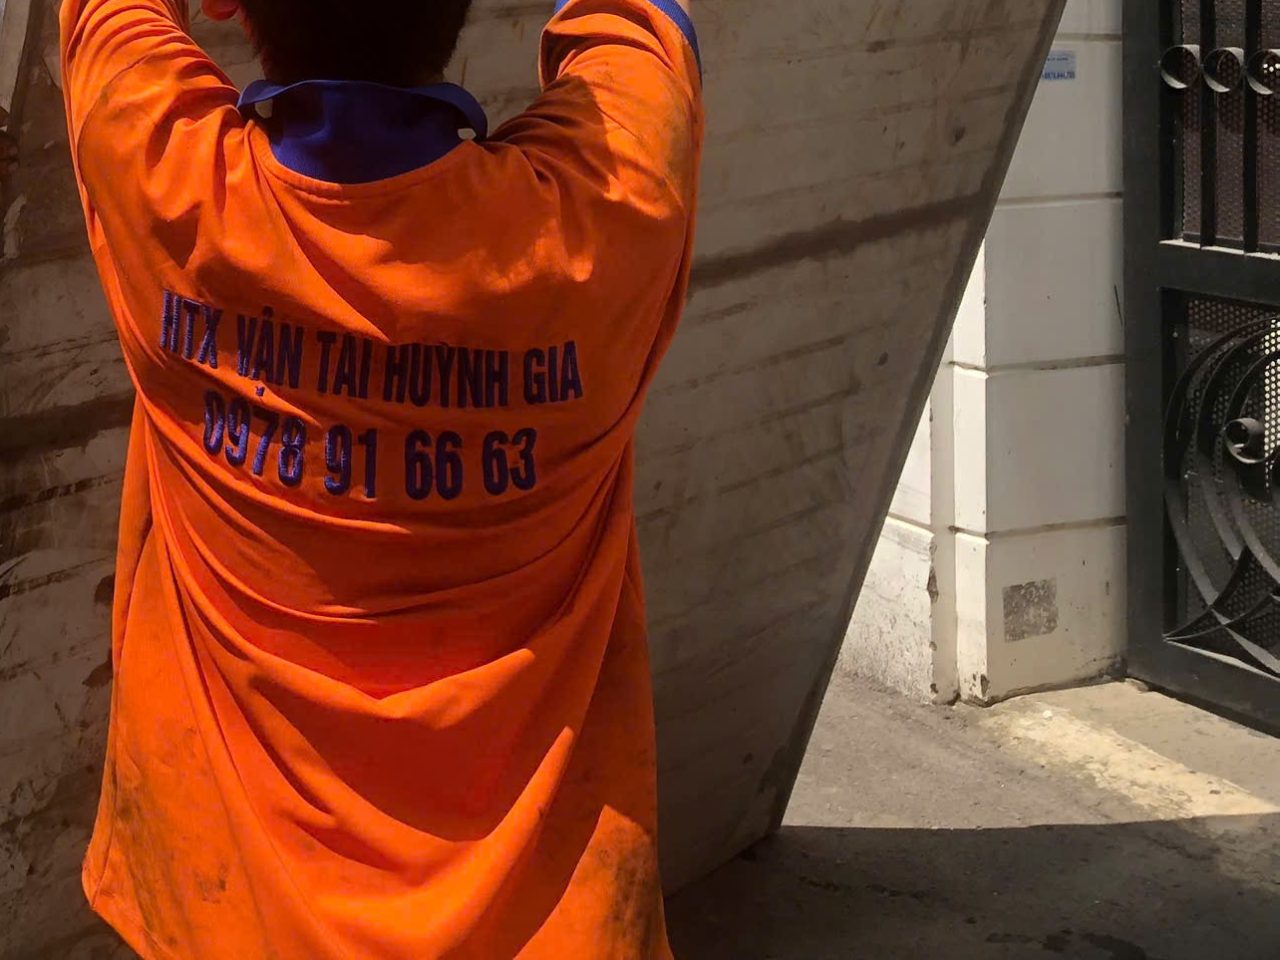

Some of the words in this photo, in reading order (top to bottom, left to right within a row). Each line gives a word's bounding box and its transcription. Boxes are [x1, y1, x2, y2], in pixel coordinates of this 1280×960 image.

[161, 289, 222, 369] HTX
[523, 341, 584, 406] GIA
[204, 390, 307, 487] 0978
[324, 424, 378, 499] 91
[404, 430, 463, 500] 66
[482, 427, 537, 496] 63
